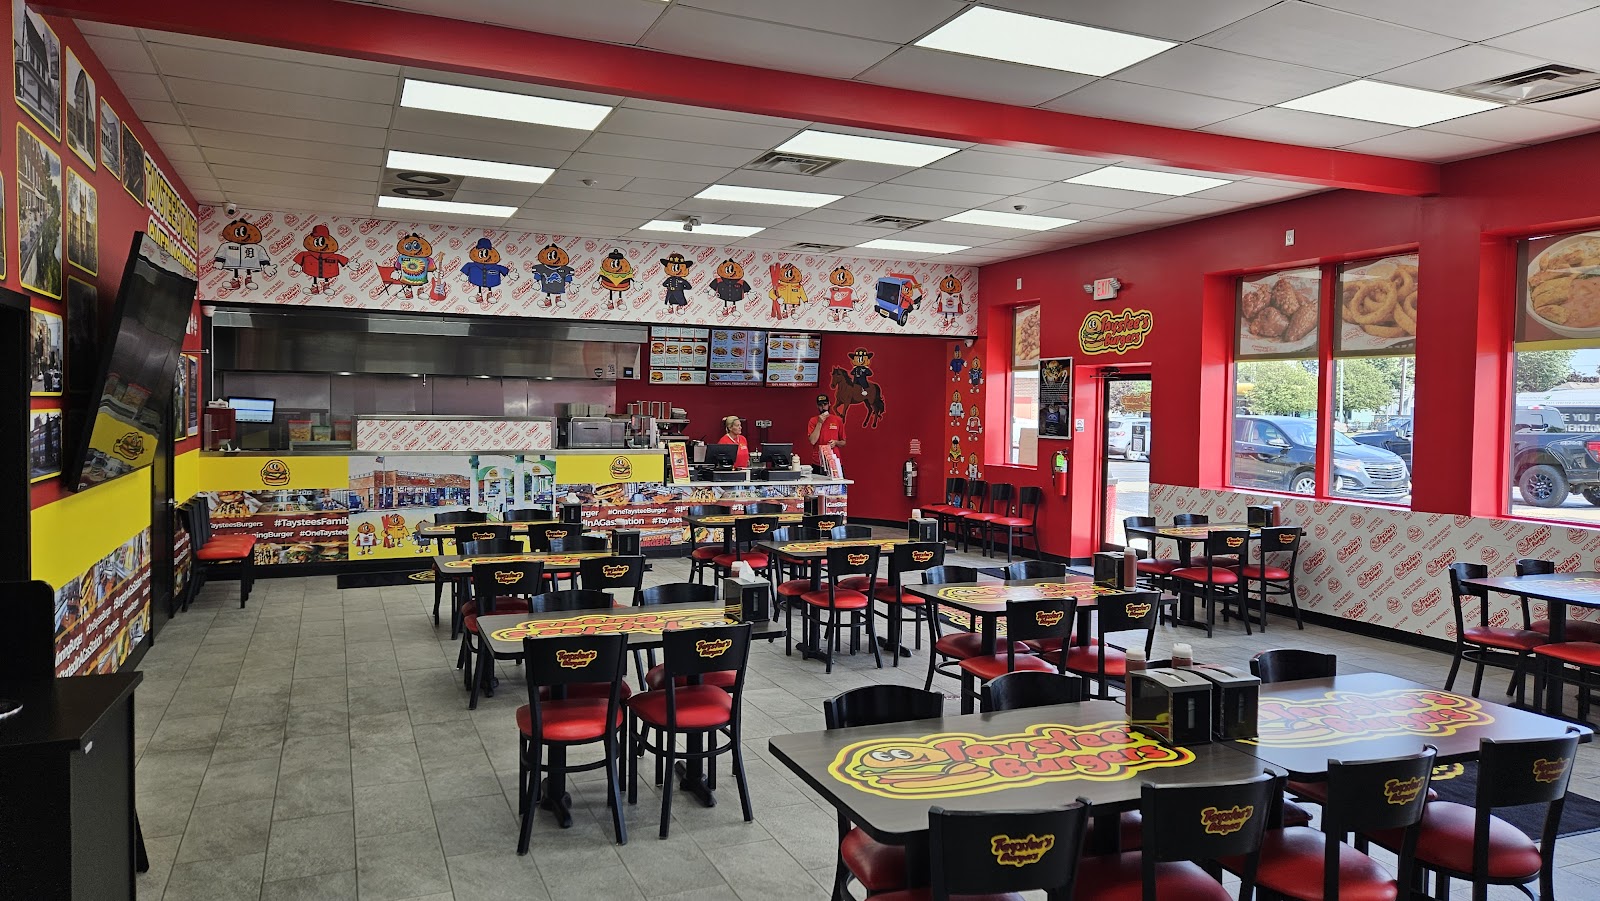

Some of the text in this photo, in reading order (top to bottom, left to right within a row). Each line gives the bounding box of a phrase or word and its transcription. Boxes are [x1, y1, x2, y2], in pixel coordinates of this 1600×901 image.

[1096, 279, 1112, 298] EXIT
[1101, 316, 1149, 334] Taystee's
[1104, 332, 1140, 348] Burgers
[1572, 414, 1590, 422] YOU
[608, 506, 668, 516] #OneTaysteeBurger
[1525, 524, 1551, 546] Taystee's
[1532, 533, 1551, 547] Burgers
[1401, 552, 1421, 569] Taystee's
[1433, 548, 1455, 566] Taystee's
[1439, 555, 1456, 569] Burgers
[1406, 559, 1422, 572] Burgers
[1419, 588, 1440, 604] Taystee's
[1425, 594, 1441, 608] Burgers
[697, 639, 732, 650] Taystee's
[702, 648, 723, 657] Burgers
[558, 650, 597, 662] Taystee's
[1259, 693, 1460, 720] Taystee's
[1324, 708, 1472, 733] Burgers
[989, 742, 1169, 778] Burgers
[1202, 806, 1253, 823] Taystee's
[1208, 821, 1241, 832] Burgers
[993, 836, 1054, 852] Taystee's
[1000, 851, 1038, 862] Burgers
